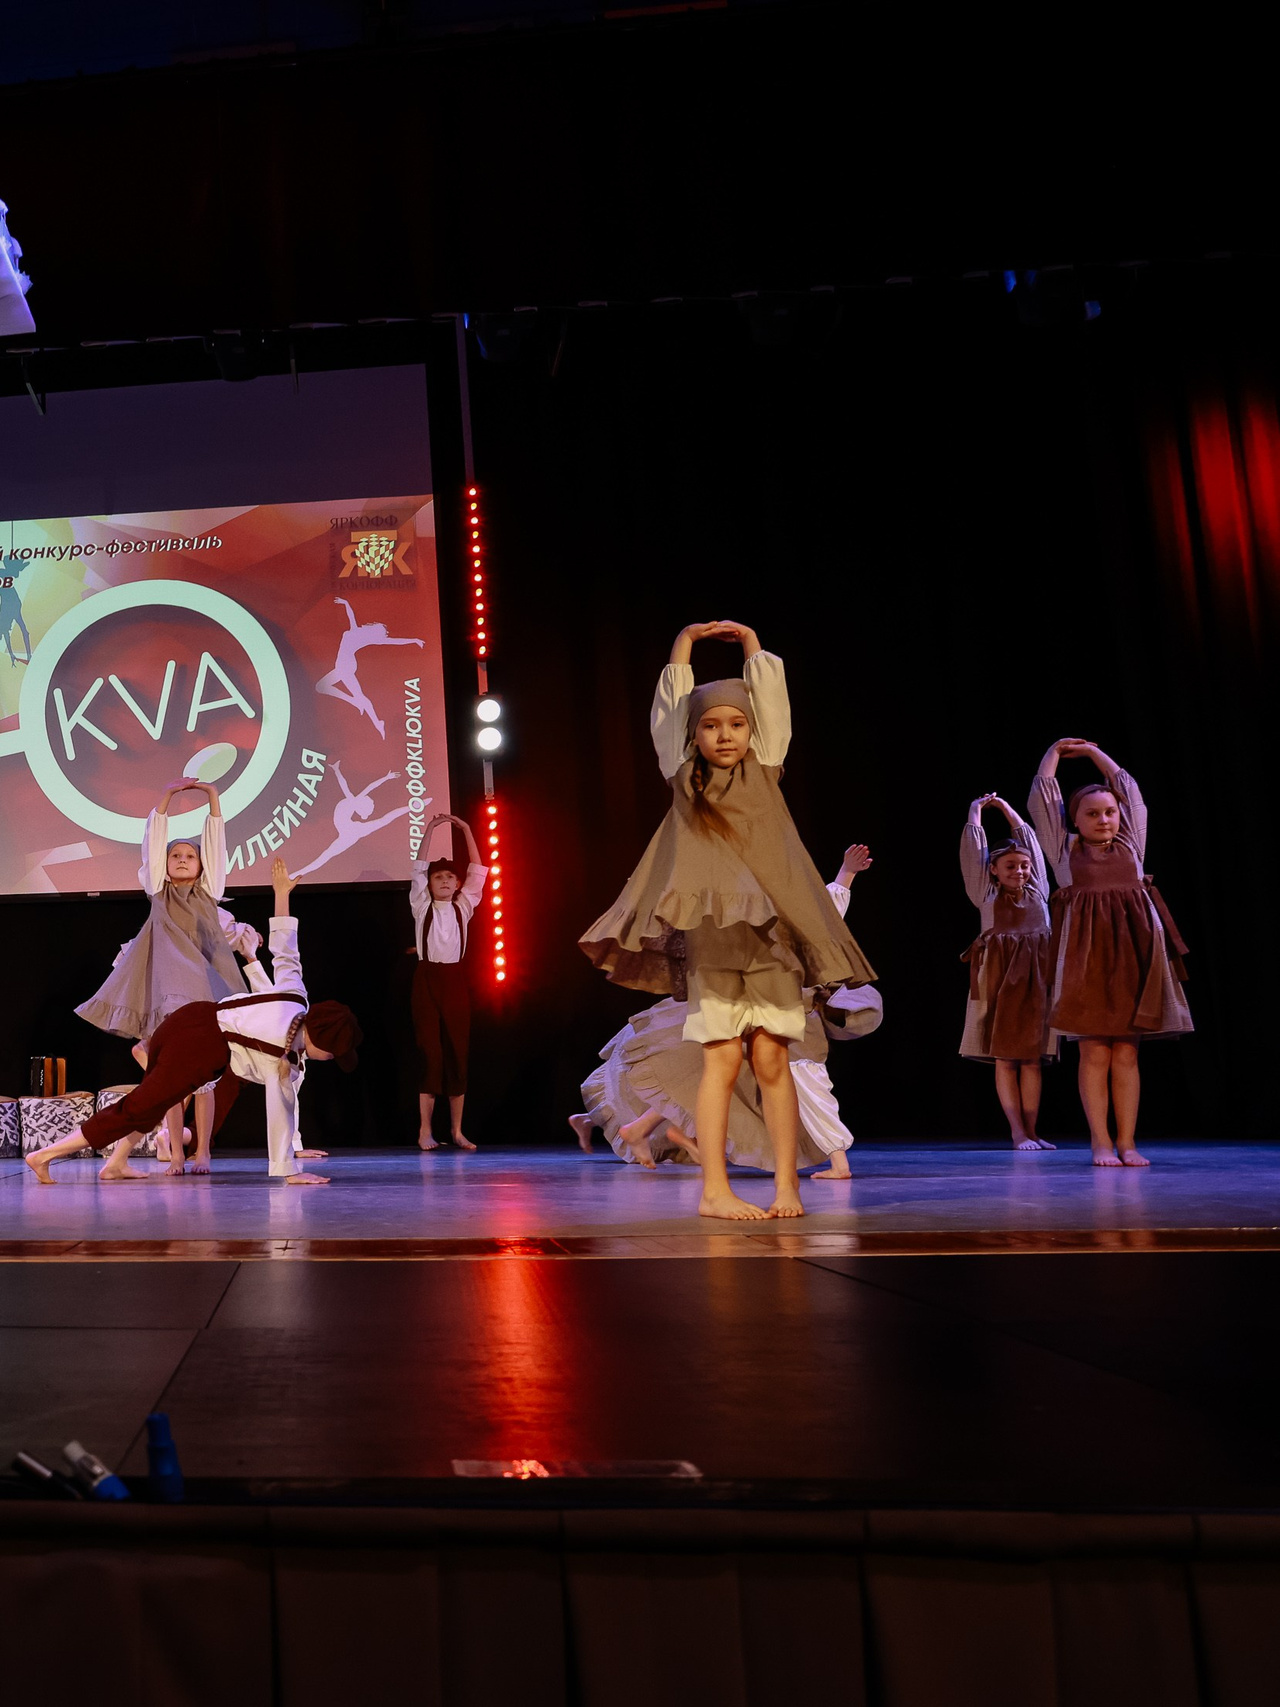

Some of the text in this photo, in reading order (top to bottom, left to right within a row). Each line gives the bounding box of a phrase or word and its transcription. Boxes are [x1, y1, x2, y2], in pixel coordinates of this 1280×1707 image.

[330, 515, 398, 529] ЯРКОФФ
[8, 536, 223, 561] конкурс-фестиваль
[224, 748, 327, 876] ИЛЕЙНАЯ
